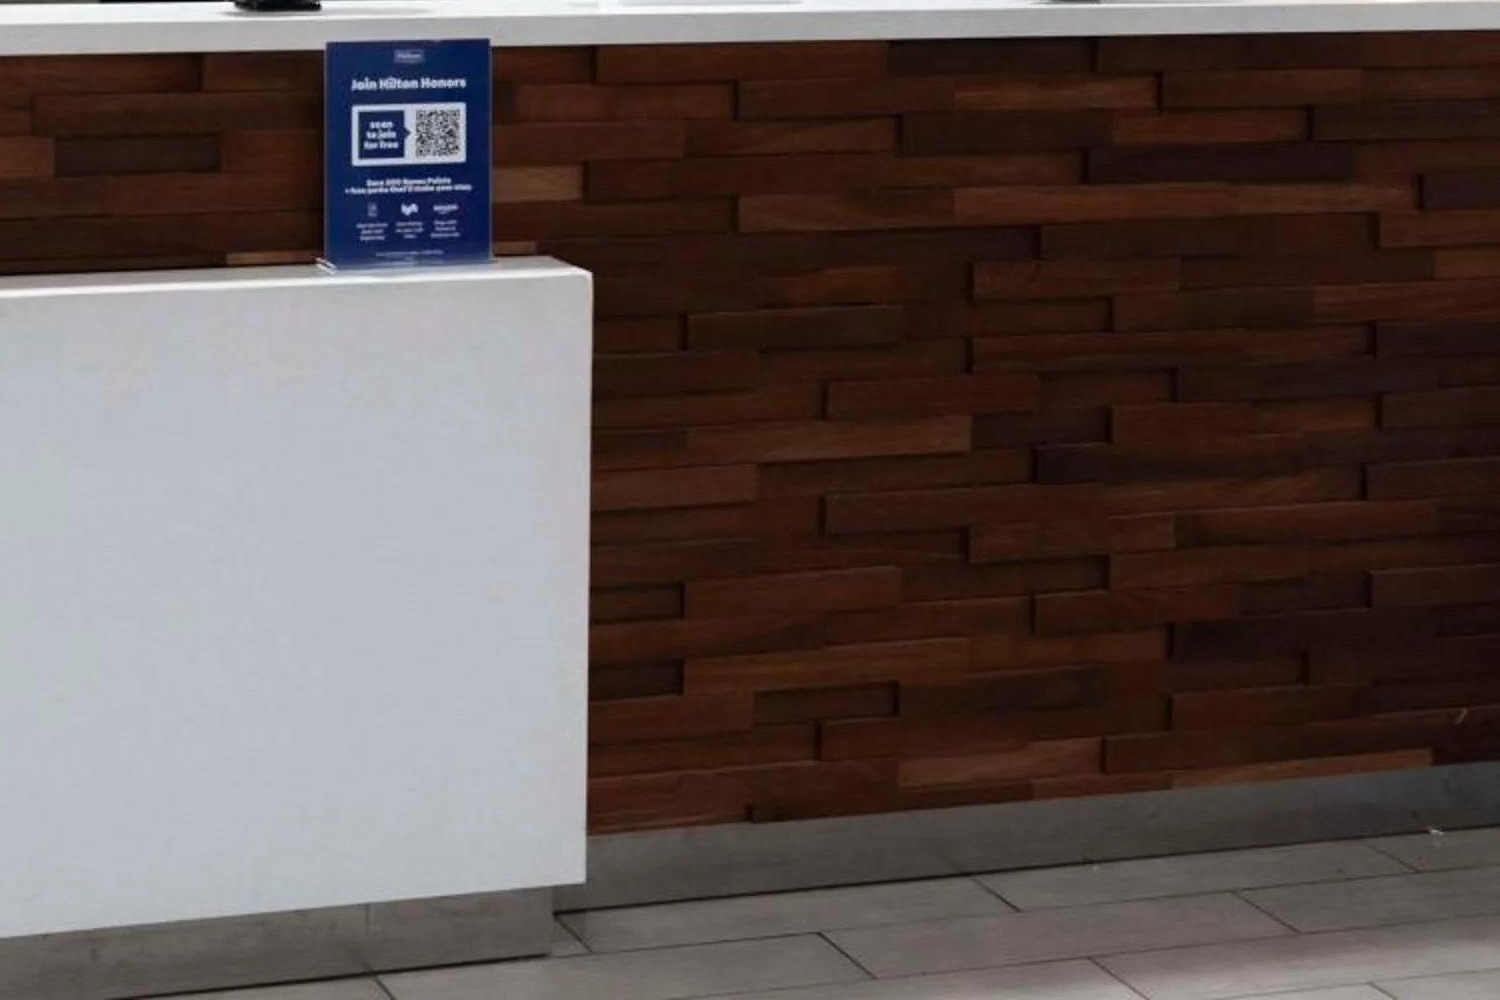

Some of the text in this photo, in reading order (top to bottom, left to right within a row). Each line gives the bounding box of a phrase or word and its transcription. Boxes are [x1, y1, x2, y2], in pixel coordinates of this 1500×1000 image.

[351, 76, 467, 91] Join Hilton Honors
